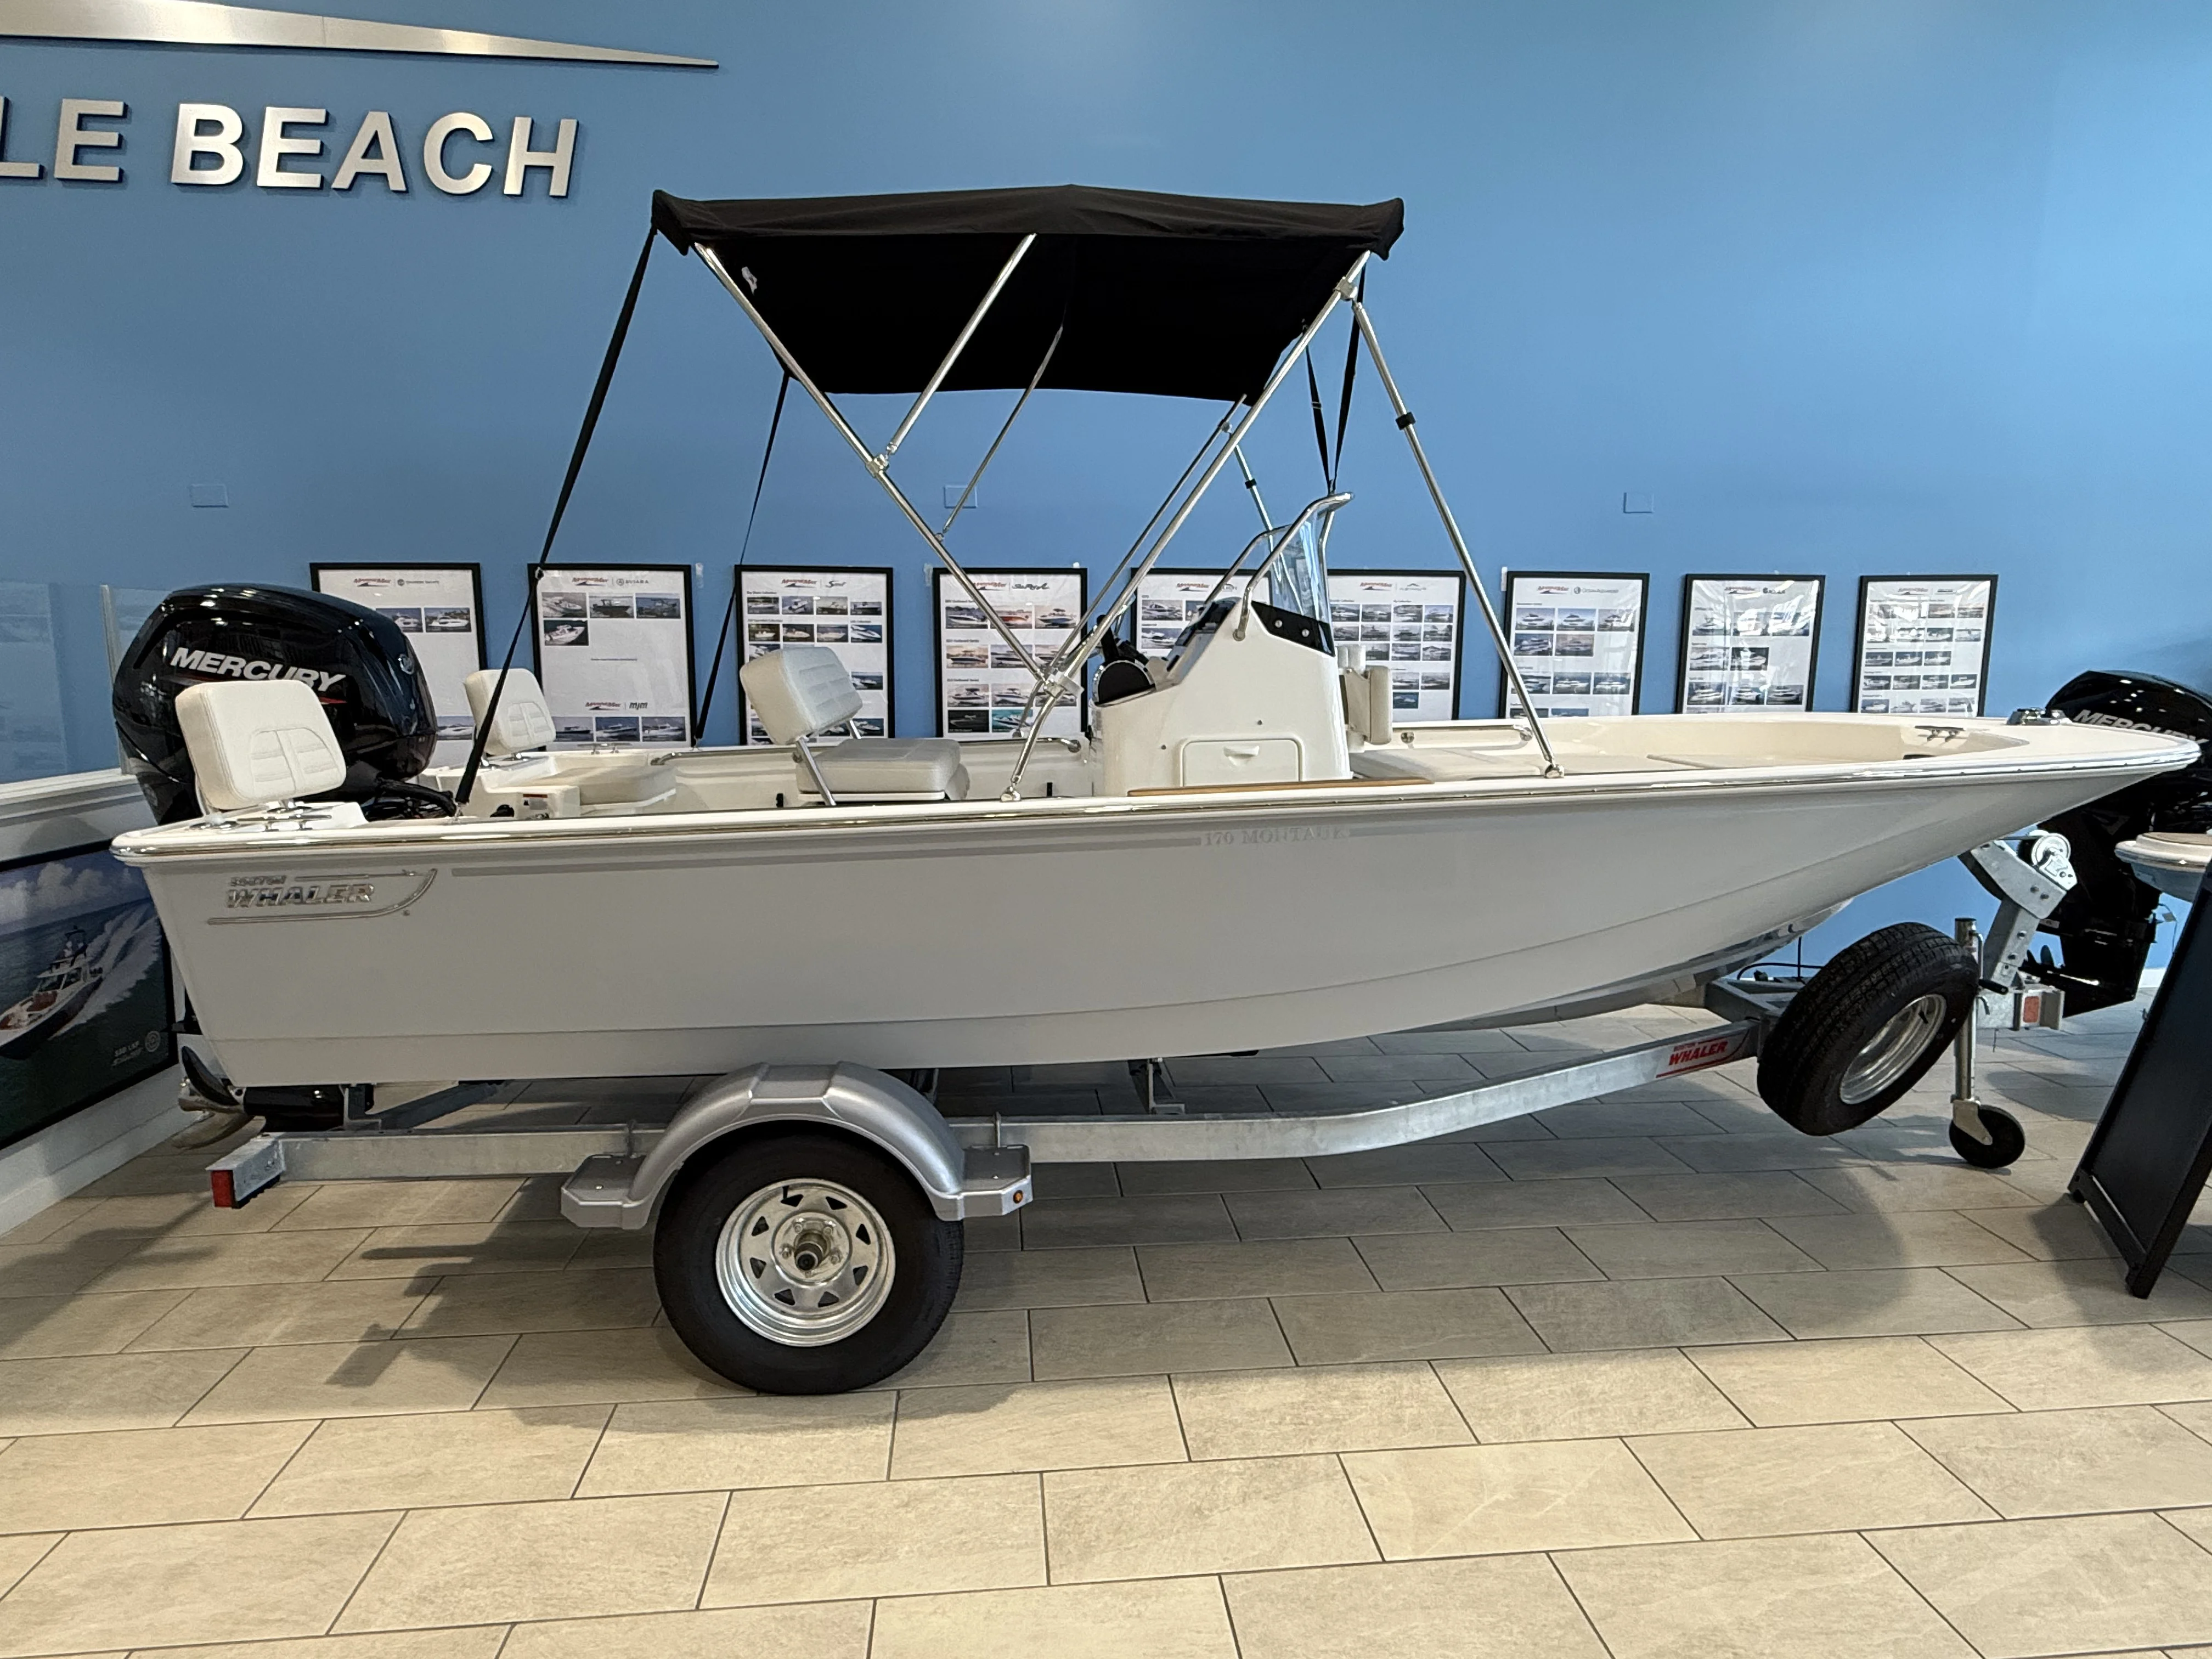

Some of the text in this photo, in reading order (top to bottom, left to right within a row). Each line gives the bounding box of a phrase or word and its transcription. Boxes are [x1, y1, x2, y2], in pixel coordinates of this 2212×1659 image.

[171, 101, 579, 198] BEACH
[170, 647, 347, 692] MERCURY
[1206, 832, 1234, 846] 170
[226, 883, 375, 909] WHALER
[1669, 1041, 1728, 1065] WHALER
